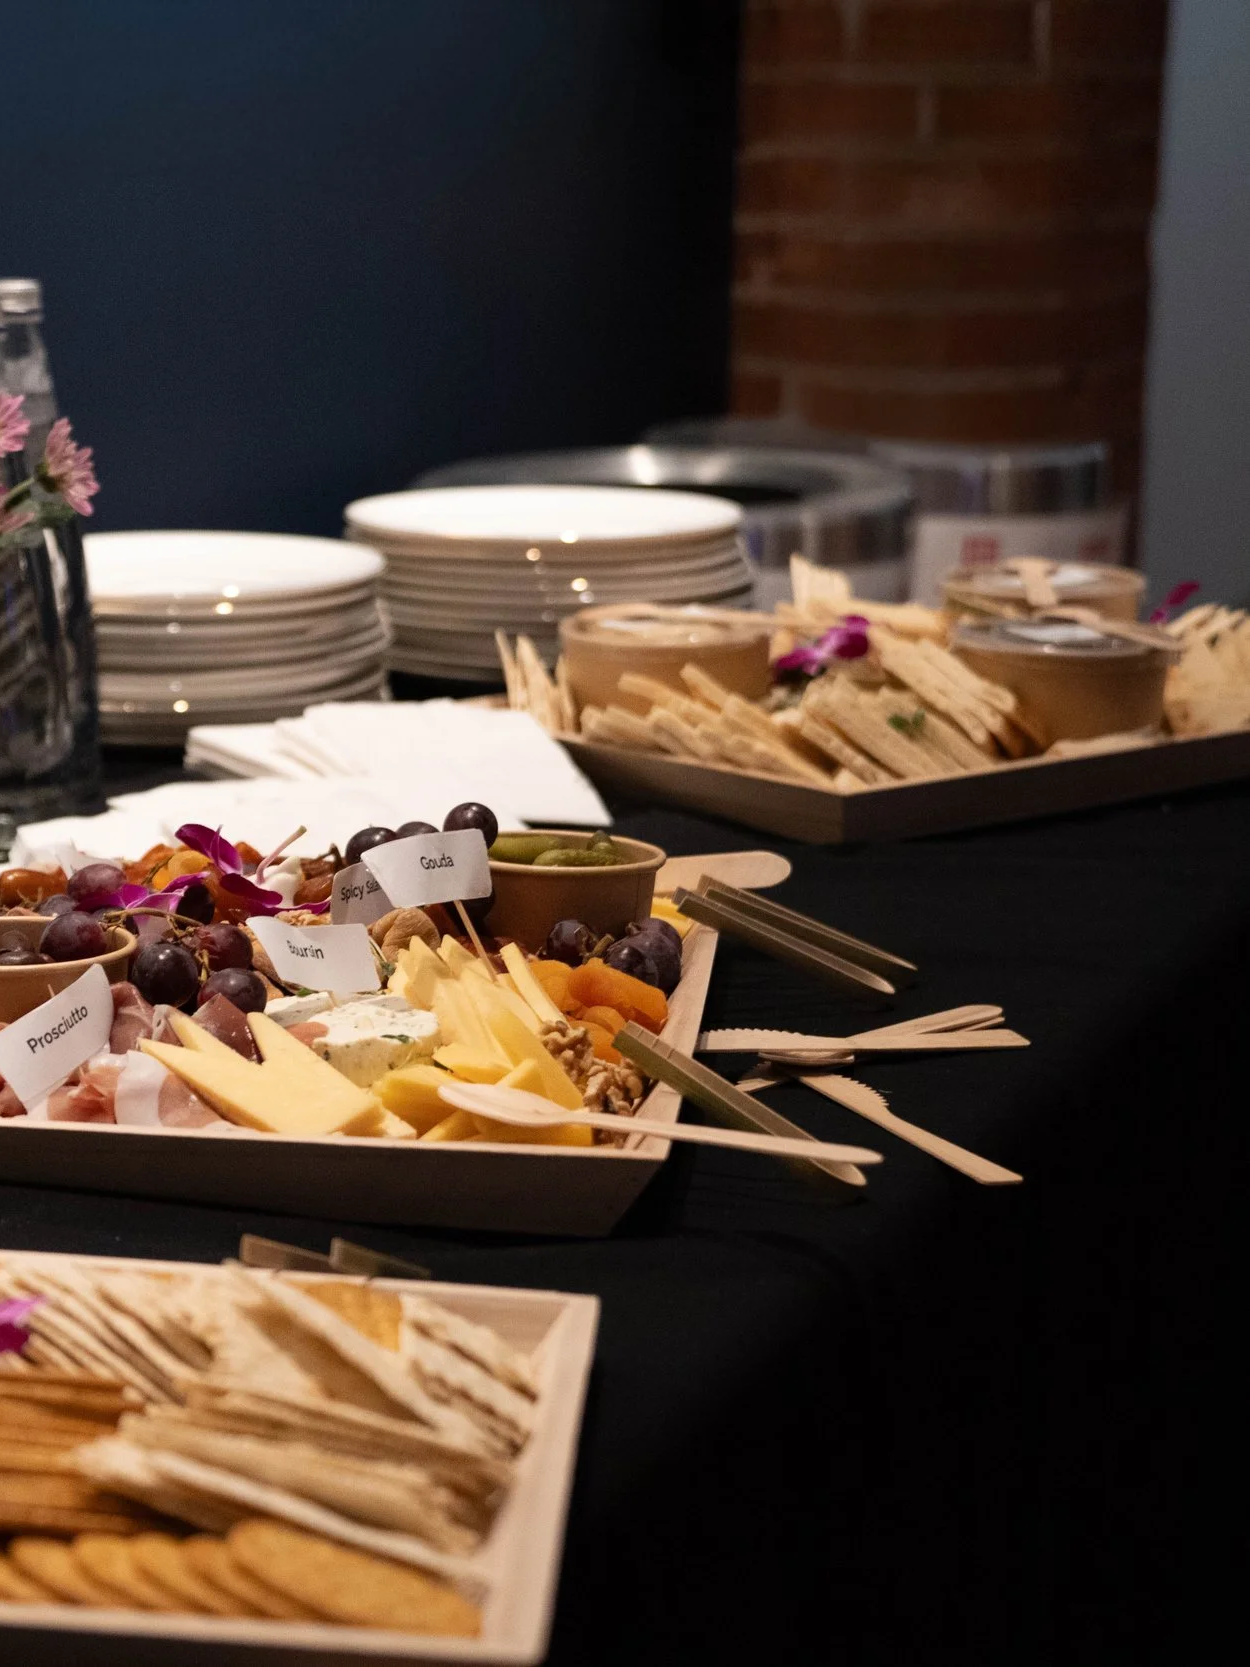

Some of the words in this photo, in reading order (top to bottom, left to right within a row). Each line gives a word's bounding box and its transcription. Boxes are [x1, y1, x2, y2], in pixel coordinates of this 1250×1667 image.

[420, 853, 454, 870] Gouda
[340, 884, 364, 904] Spicy
[26, 1005, 88, 1054] Prosciutto
